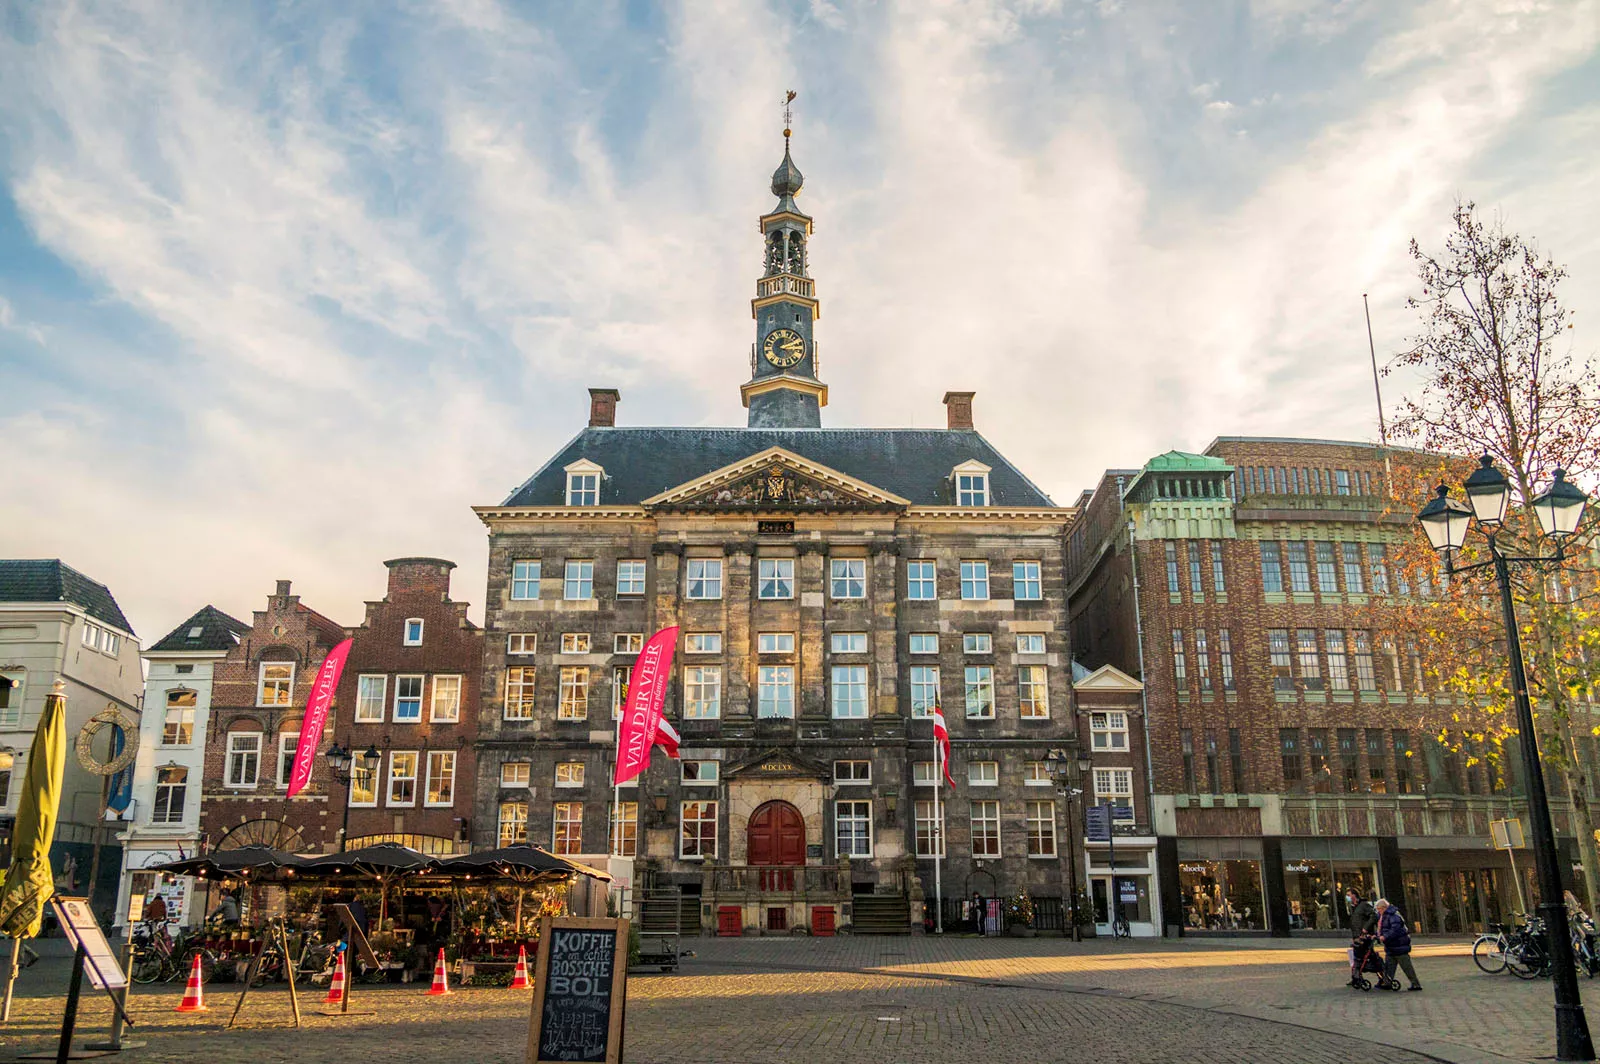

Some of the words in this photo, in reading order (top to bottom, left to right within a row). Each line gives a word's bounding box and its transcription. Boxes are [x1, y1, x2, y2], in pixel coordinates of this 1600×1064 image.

[640, 644, 660, 686] VEER
[655, 674, 664, 701] planten
[632, 690, 650, 727] DER
[298, 744, 311, 781] VAN
[316, 659, 335, 701] VEER
[626, 731, 644, 768] VAN
[1286, 864, 1309, 872] shoeby
[552, 932, 612, 952] KOFFIE
[551, 960, 610, 977] BOSSCHE
[550, 977, 609, 996] BOL
[547, 1012, 602, 1029] APPEL
[545, 1029, 602, 1047] TAART
